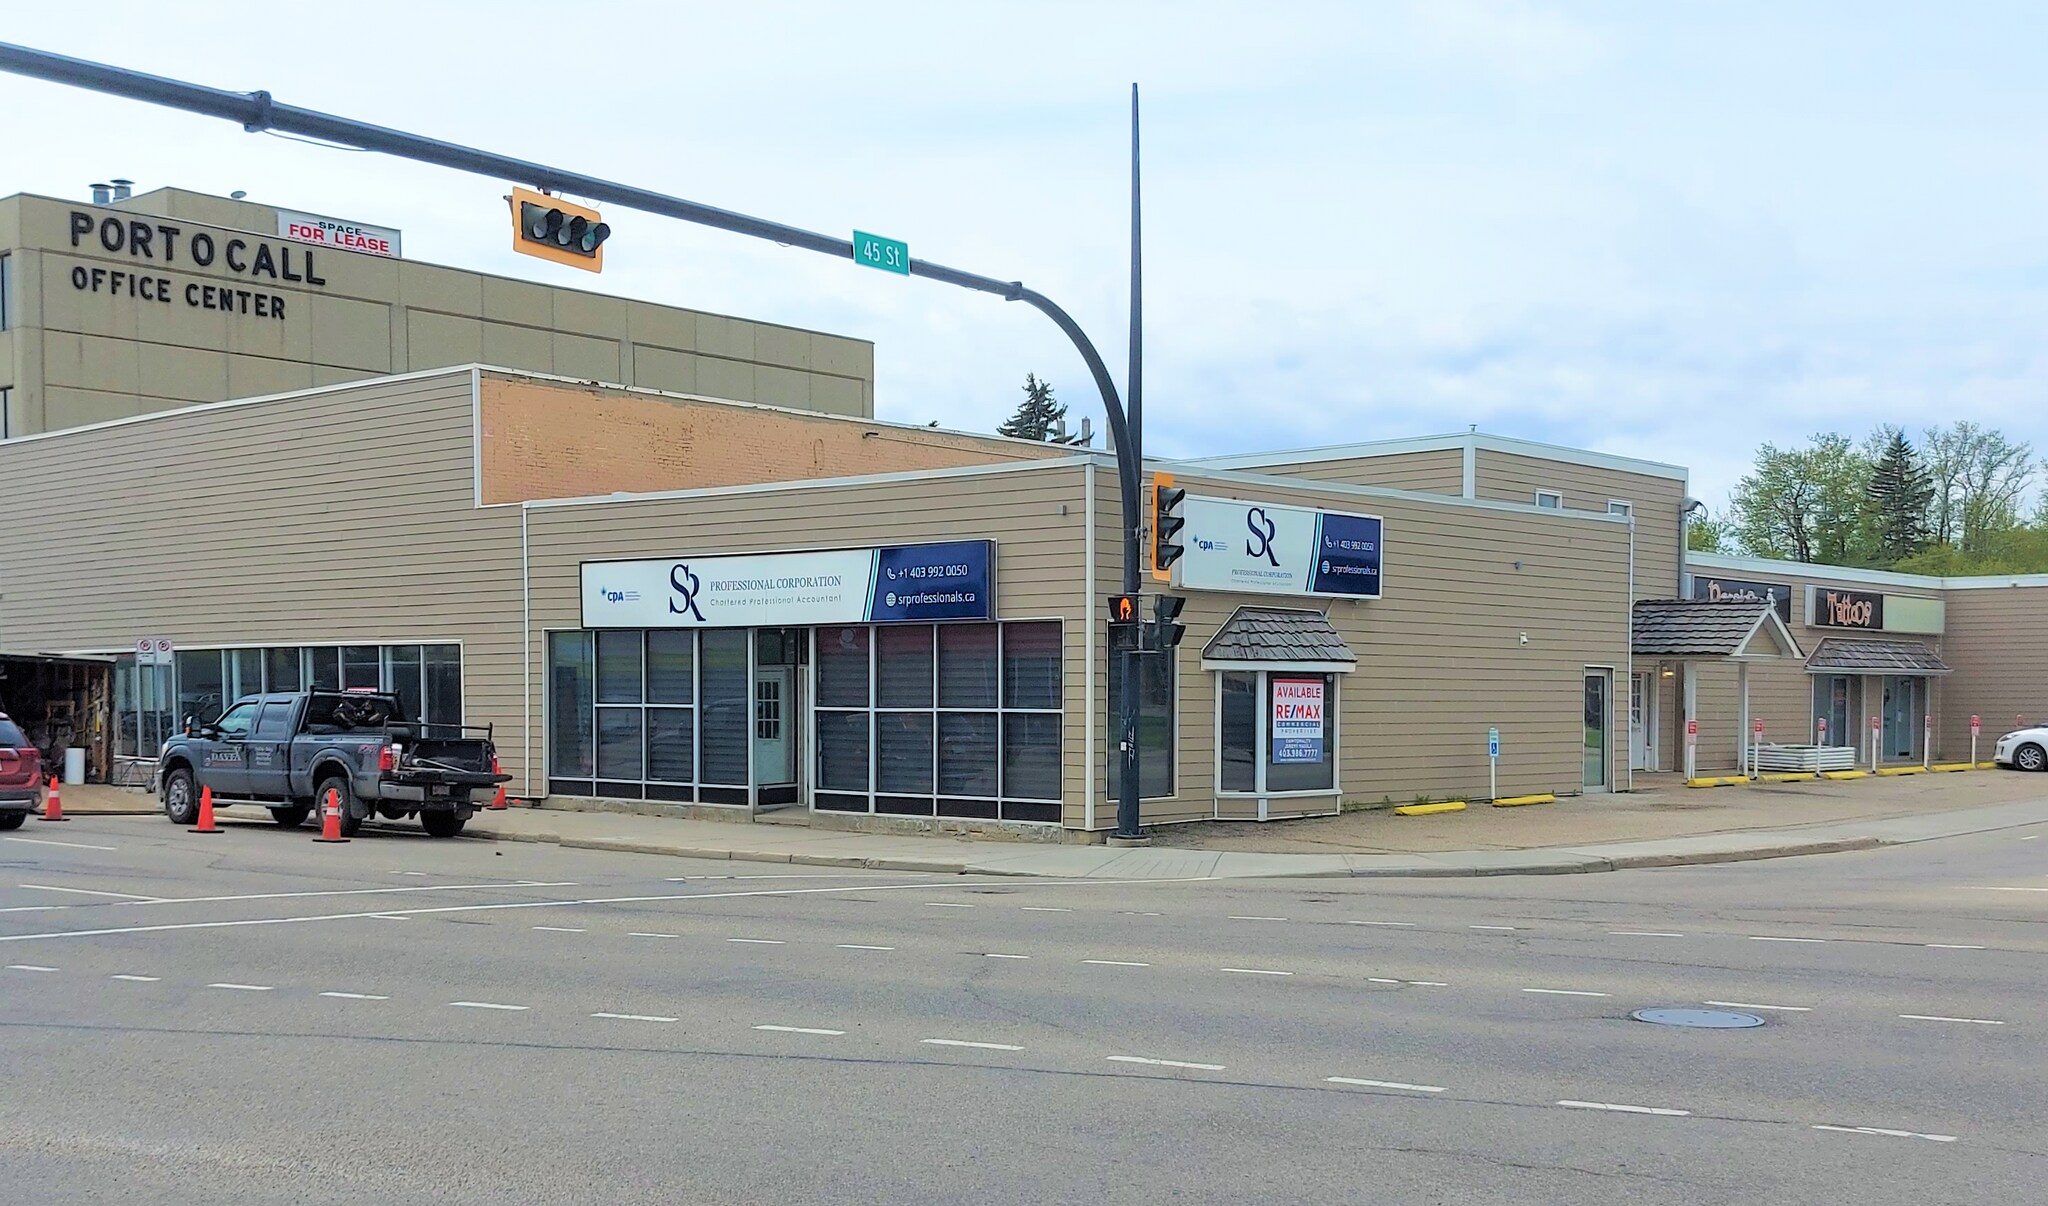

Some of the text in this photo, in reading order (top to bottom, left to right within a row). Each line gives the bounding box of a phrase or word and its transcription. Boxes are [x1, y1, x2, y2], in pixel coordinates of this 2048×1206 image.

[289, 223, 325, 241] FOR
[334, 232, 389, 252] LEASE
[318, 221, 362, 236] SPACE
[70, 211, 181, 262] PORT
[226, 239, 326, 285] CALL
[863, 241, 900, 267] 45 St
[72, 266, 286, 320] OFFICE CENTER
[1246, 507, 1280, 566] SR
[898, 564, 968, 579] +1 403 992 0050
[669, 564, 706, 621] SR
[710, 575, 841, 591] PROFESSIONAL CORPORATION
[898, 590, 975, 607] srprofessionals.ca
[1276, 687, 1321, 698] AVAILABLE
[1276, 704, 1321, 719] RE/MAX
